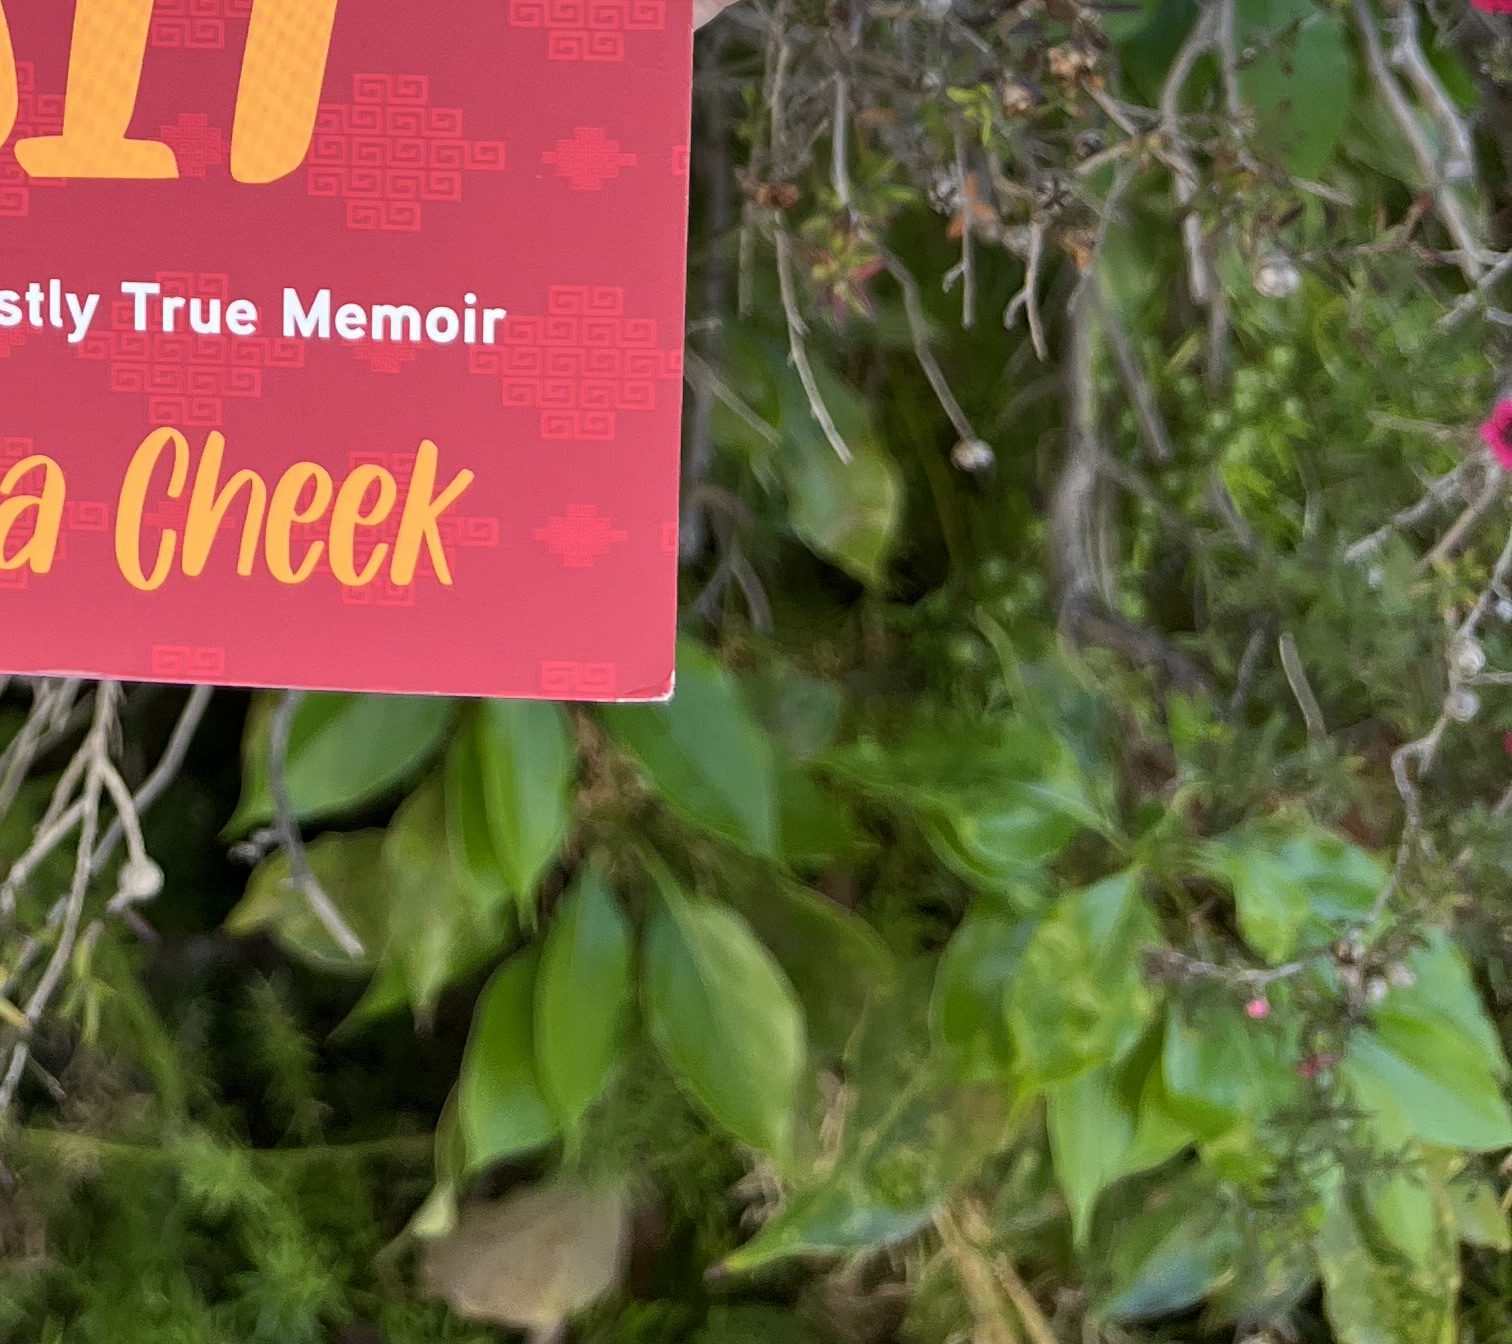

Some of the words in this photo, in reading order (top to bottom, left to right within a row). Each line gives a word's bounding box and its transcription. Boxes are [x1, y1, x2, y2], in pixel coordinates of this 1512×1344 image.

[120, 281, 258, 336] True
[282, 287, 508, 345] Memoir
[113, 426, 476, 592] Cheek
